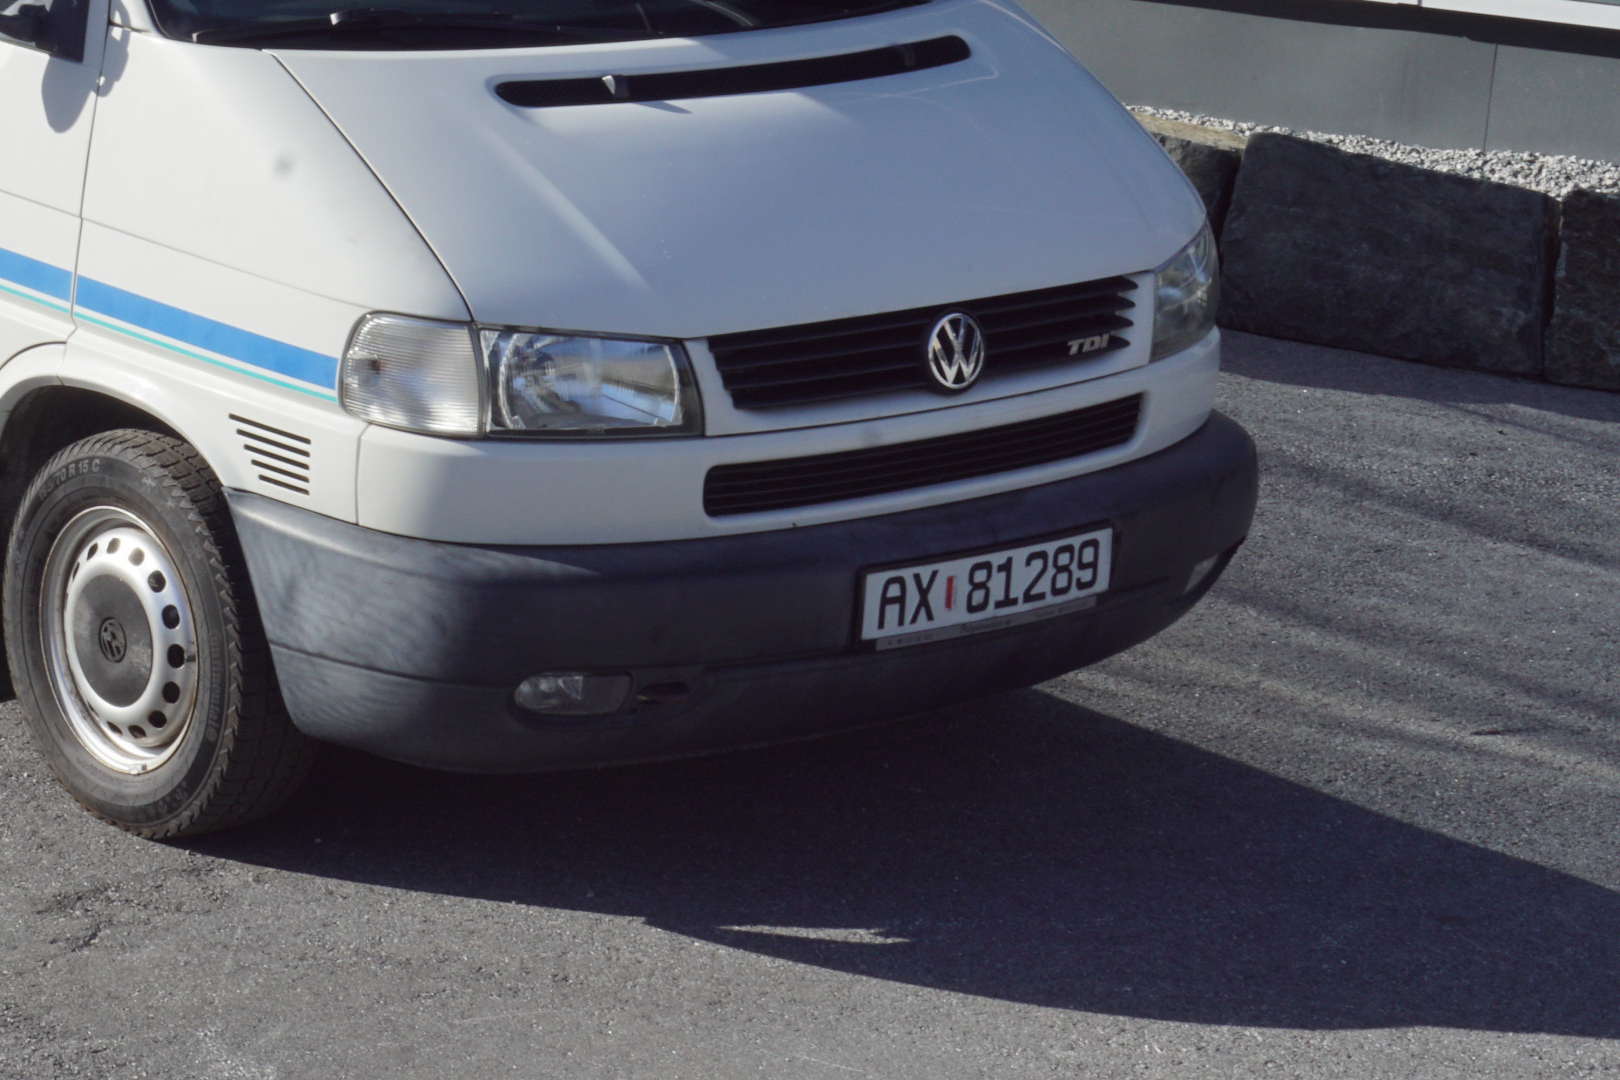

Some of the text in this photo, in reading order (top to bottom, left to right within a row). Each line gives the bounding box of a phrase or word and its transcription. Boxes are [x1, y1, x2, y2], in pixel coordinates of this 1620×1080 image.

[1067, 333, 1110, 356] TDI
[78, 459, 89, 474] 15
[91, 458, 101, 473] C
[877, 538, 1100, 630] AX 81289
